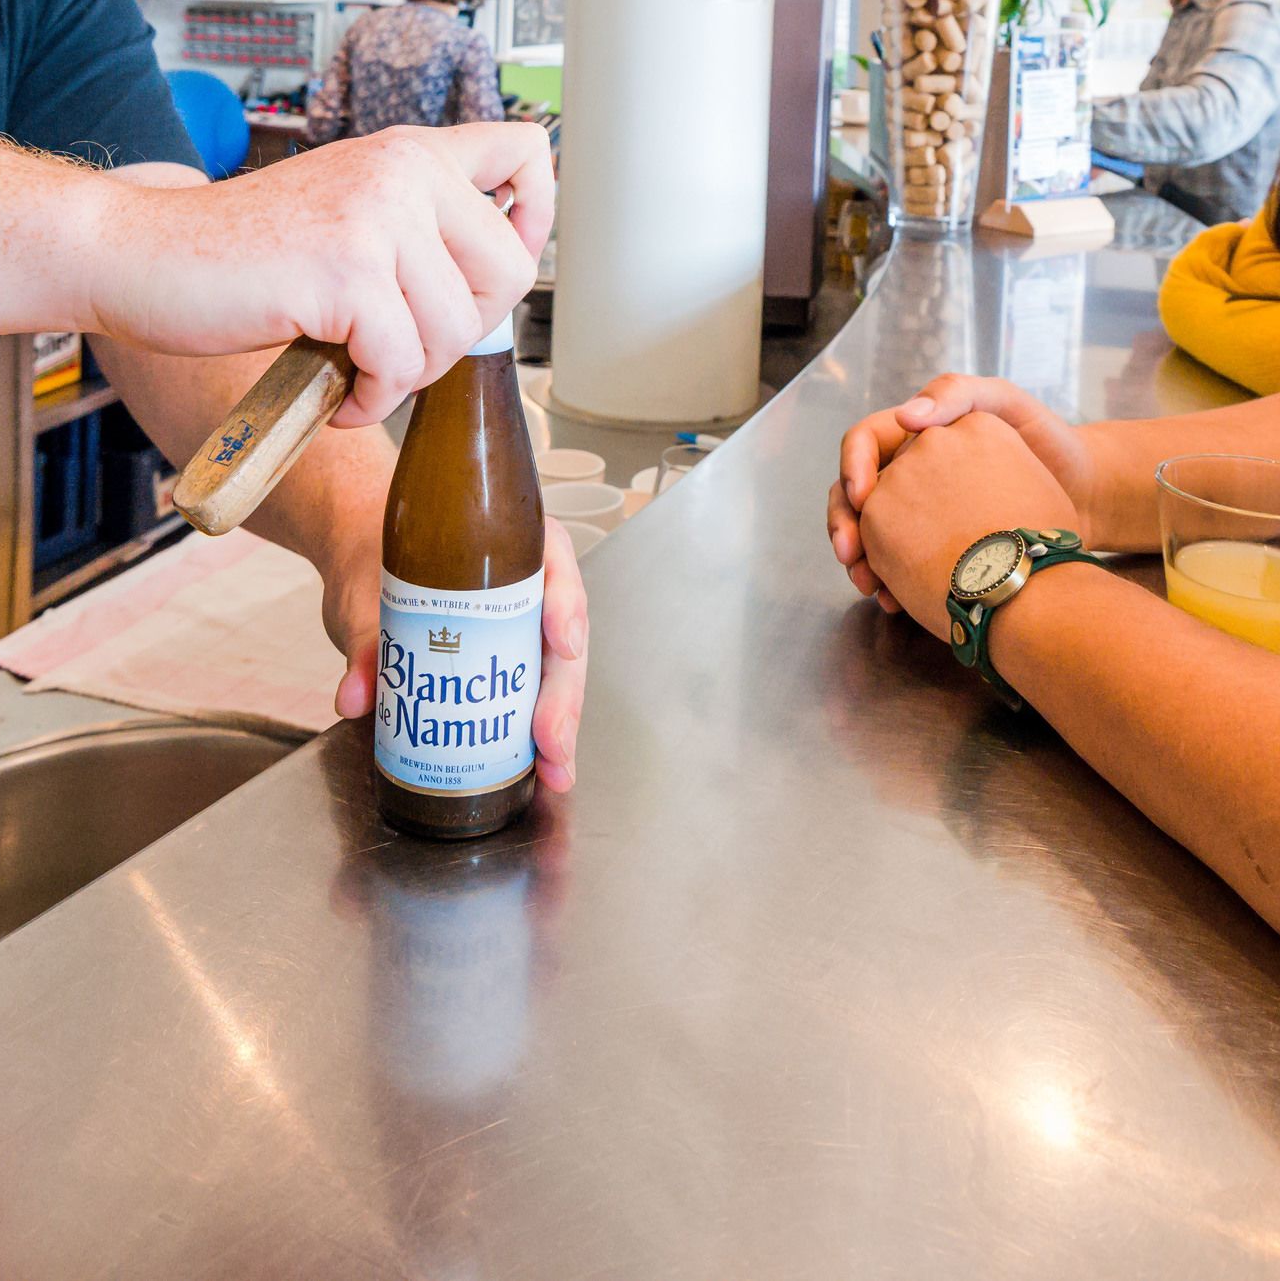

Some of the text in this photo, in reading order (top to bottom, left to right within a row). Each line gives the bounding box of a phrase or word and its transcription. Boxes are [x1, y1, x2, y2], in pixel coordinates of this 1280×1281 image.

[391, 594, 419, 607] BLANCHE
[431, 599, 470, 610] WITBIER
[484, 597, 530, 613] WHEAT BEER
[379, 629, 526, 705] Blanche
[378, 692, 516, 748] de Namur
[400, 755, 485, 774] BREWED IN BELGIUM
[418, 774, 462, 785] ANNO 1858
